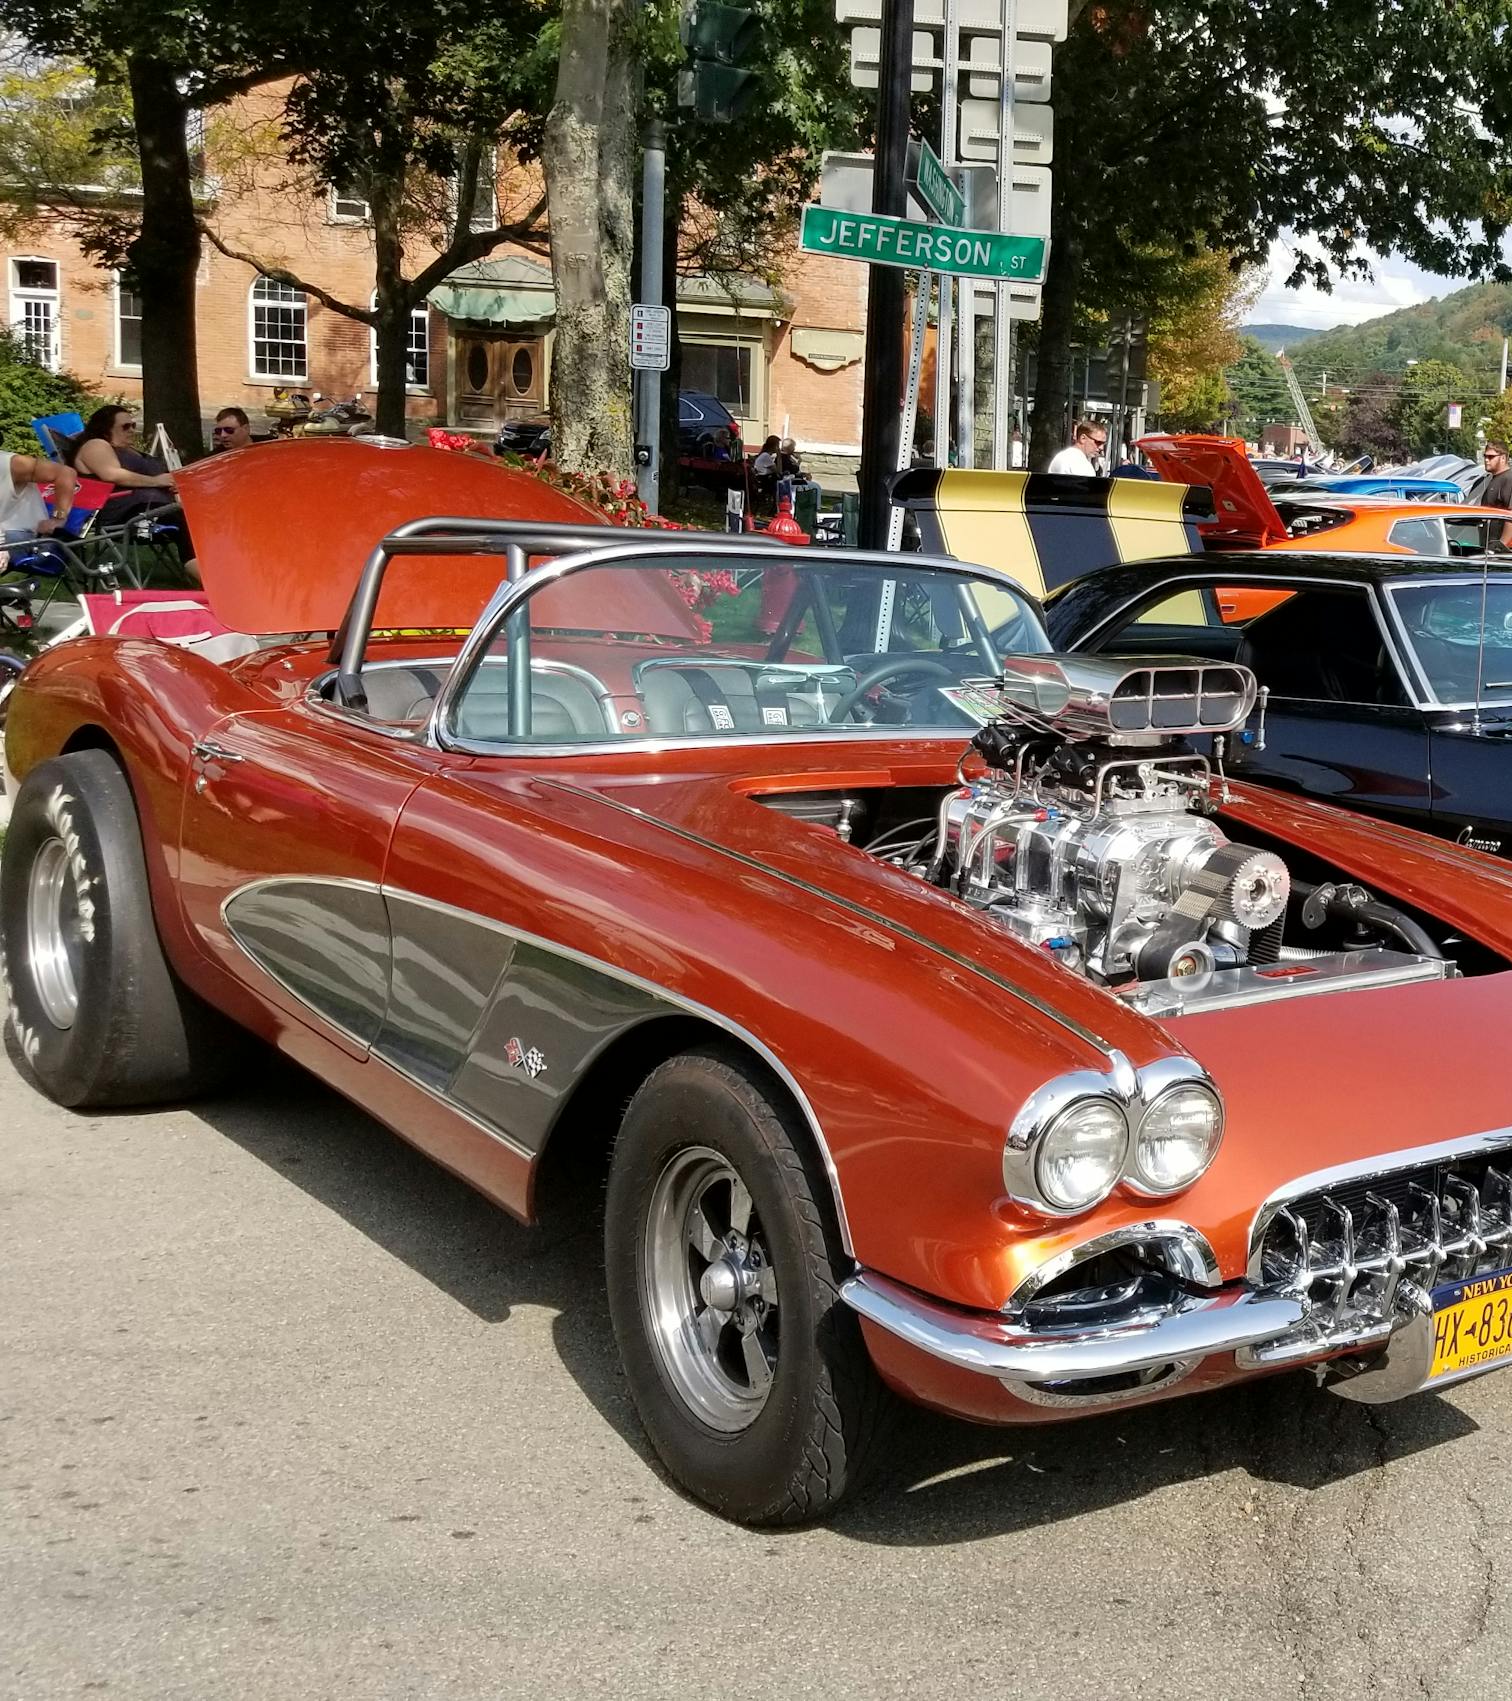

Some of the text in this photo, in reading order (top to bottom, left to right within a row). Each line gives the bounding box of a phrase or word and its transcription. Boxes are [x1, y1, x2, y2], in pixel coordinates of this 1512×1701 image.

[924, 156, 954, 223] WASHINGTON
[819, 219, 1026, 270] JEFFERSON ST
[1462, 1279, 1497, 1301] NEW
